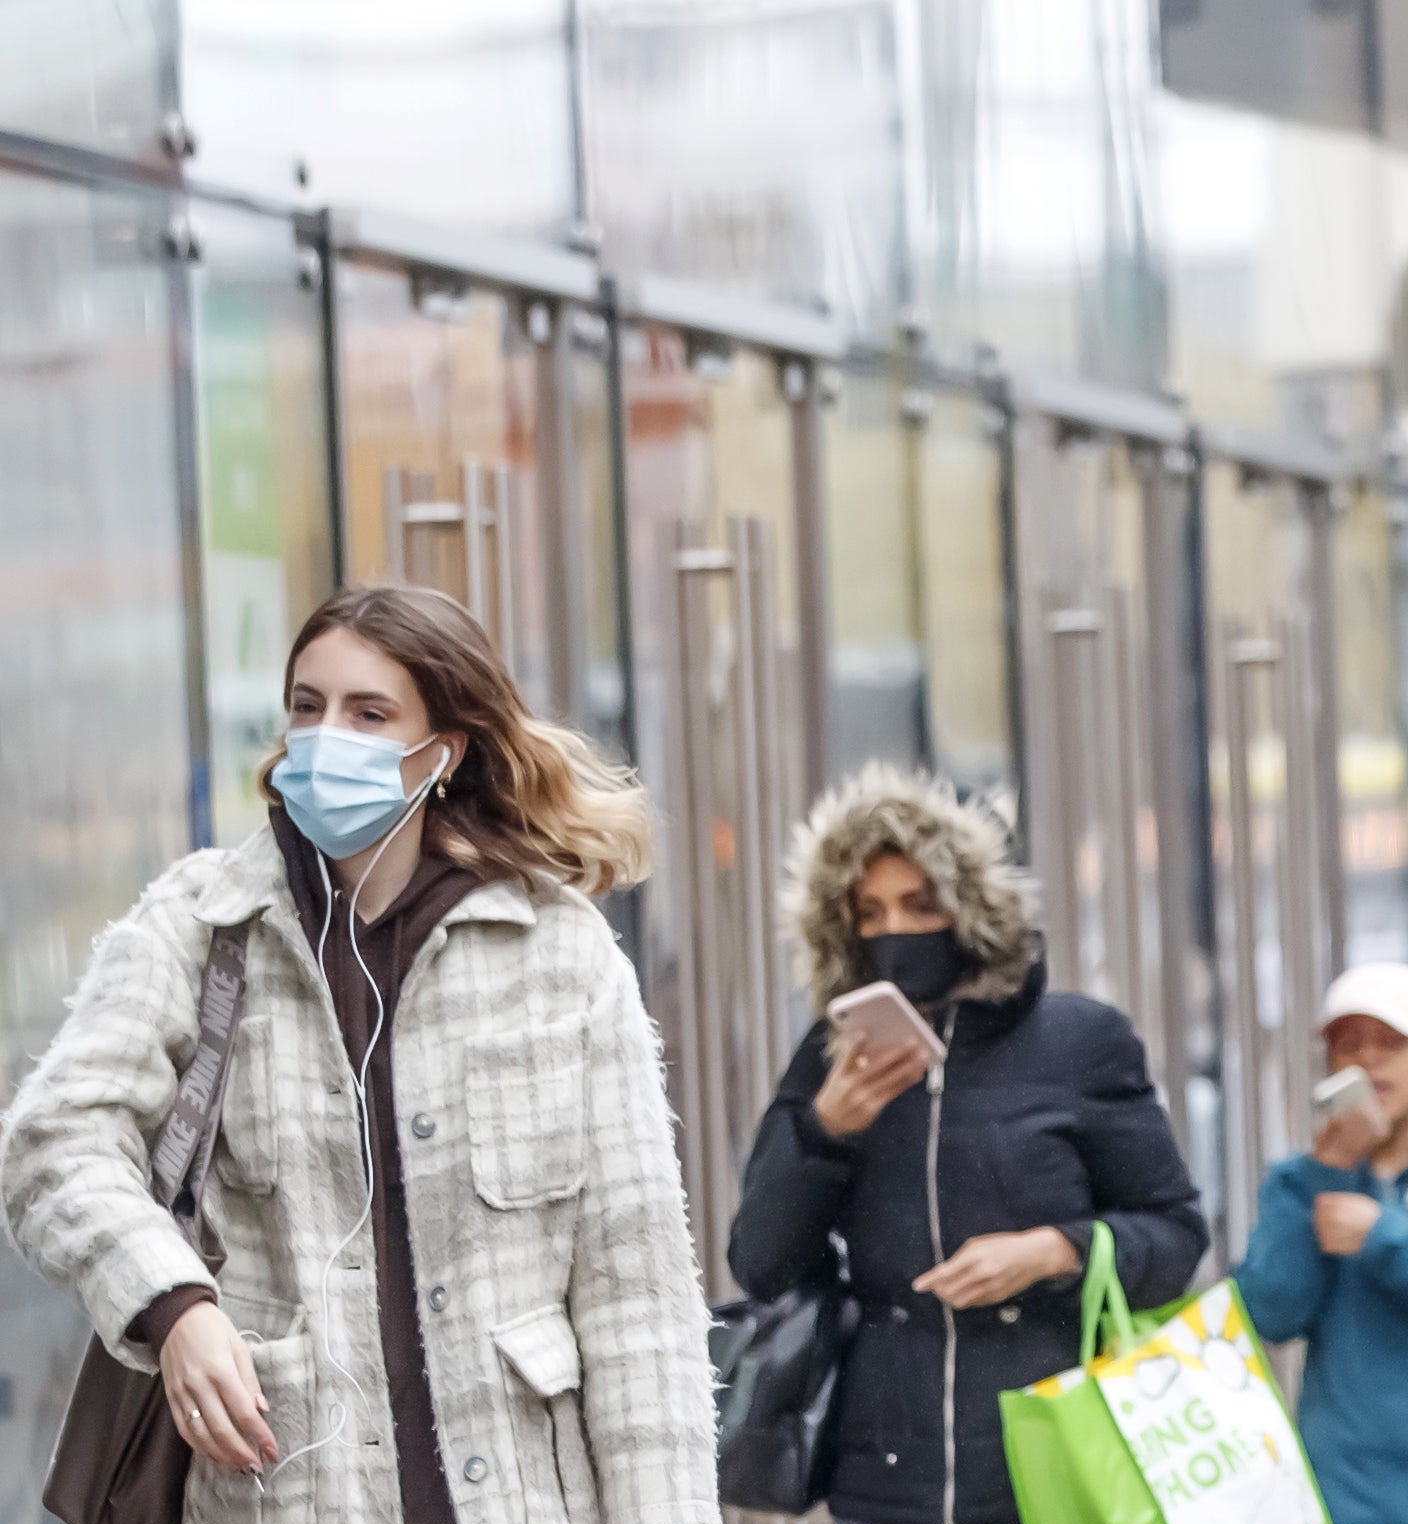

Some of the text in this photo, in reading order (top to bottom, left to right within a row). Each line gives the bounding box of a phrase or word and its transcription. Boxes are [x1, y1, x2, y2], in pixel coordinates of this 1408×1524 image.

[202, 965, 240, 1039] NIKE
[181, 1043, 222, 1115] NIKE
[156, 1112, 197, 1188] NIKE
